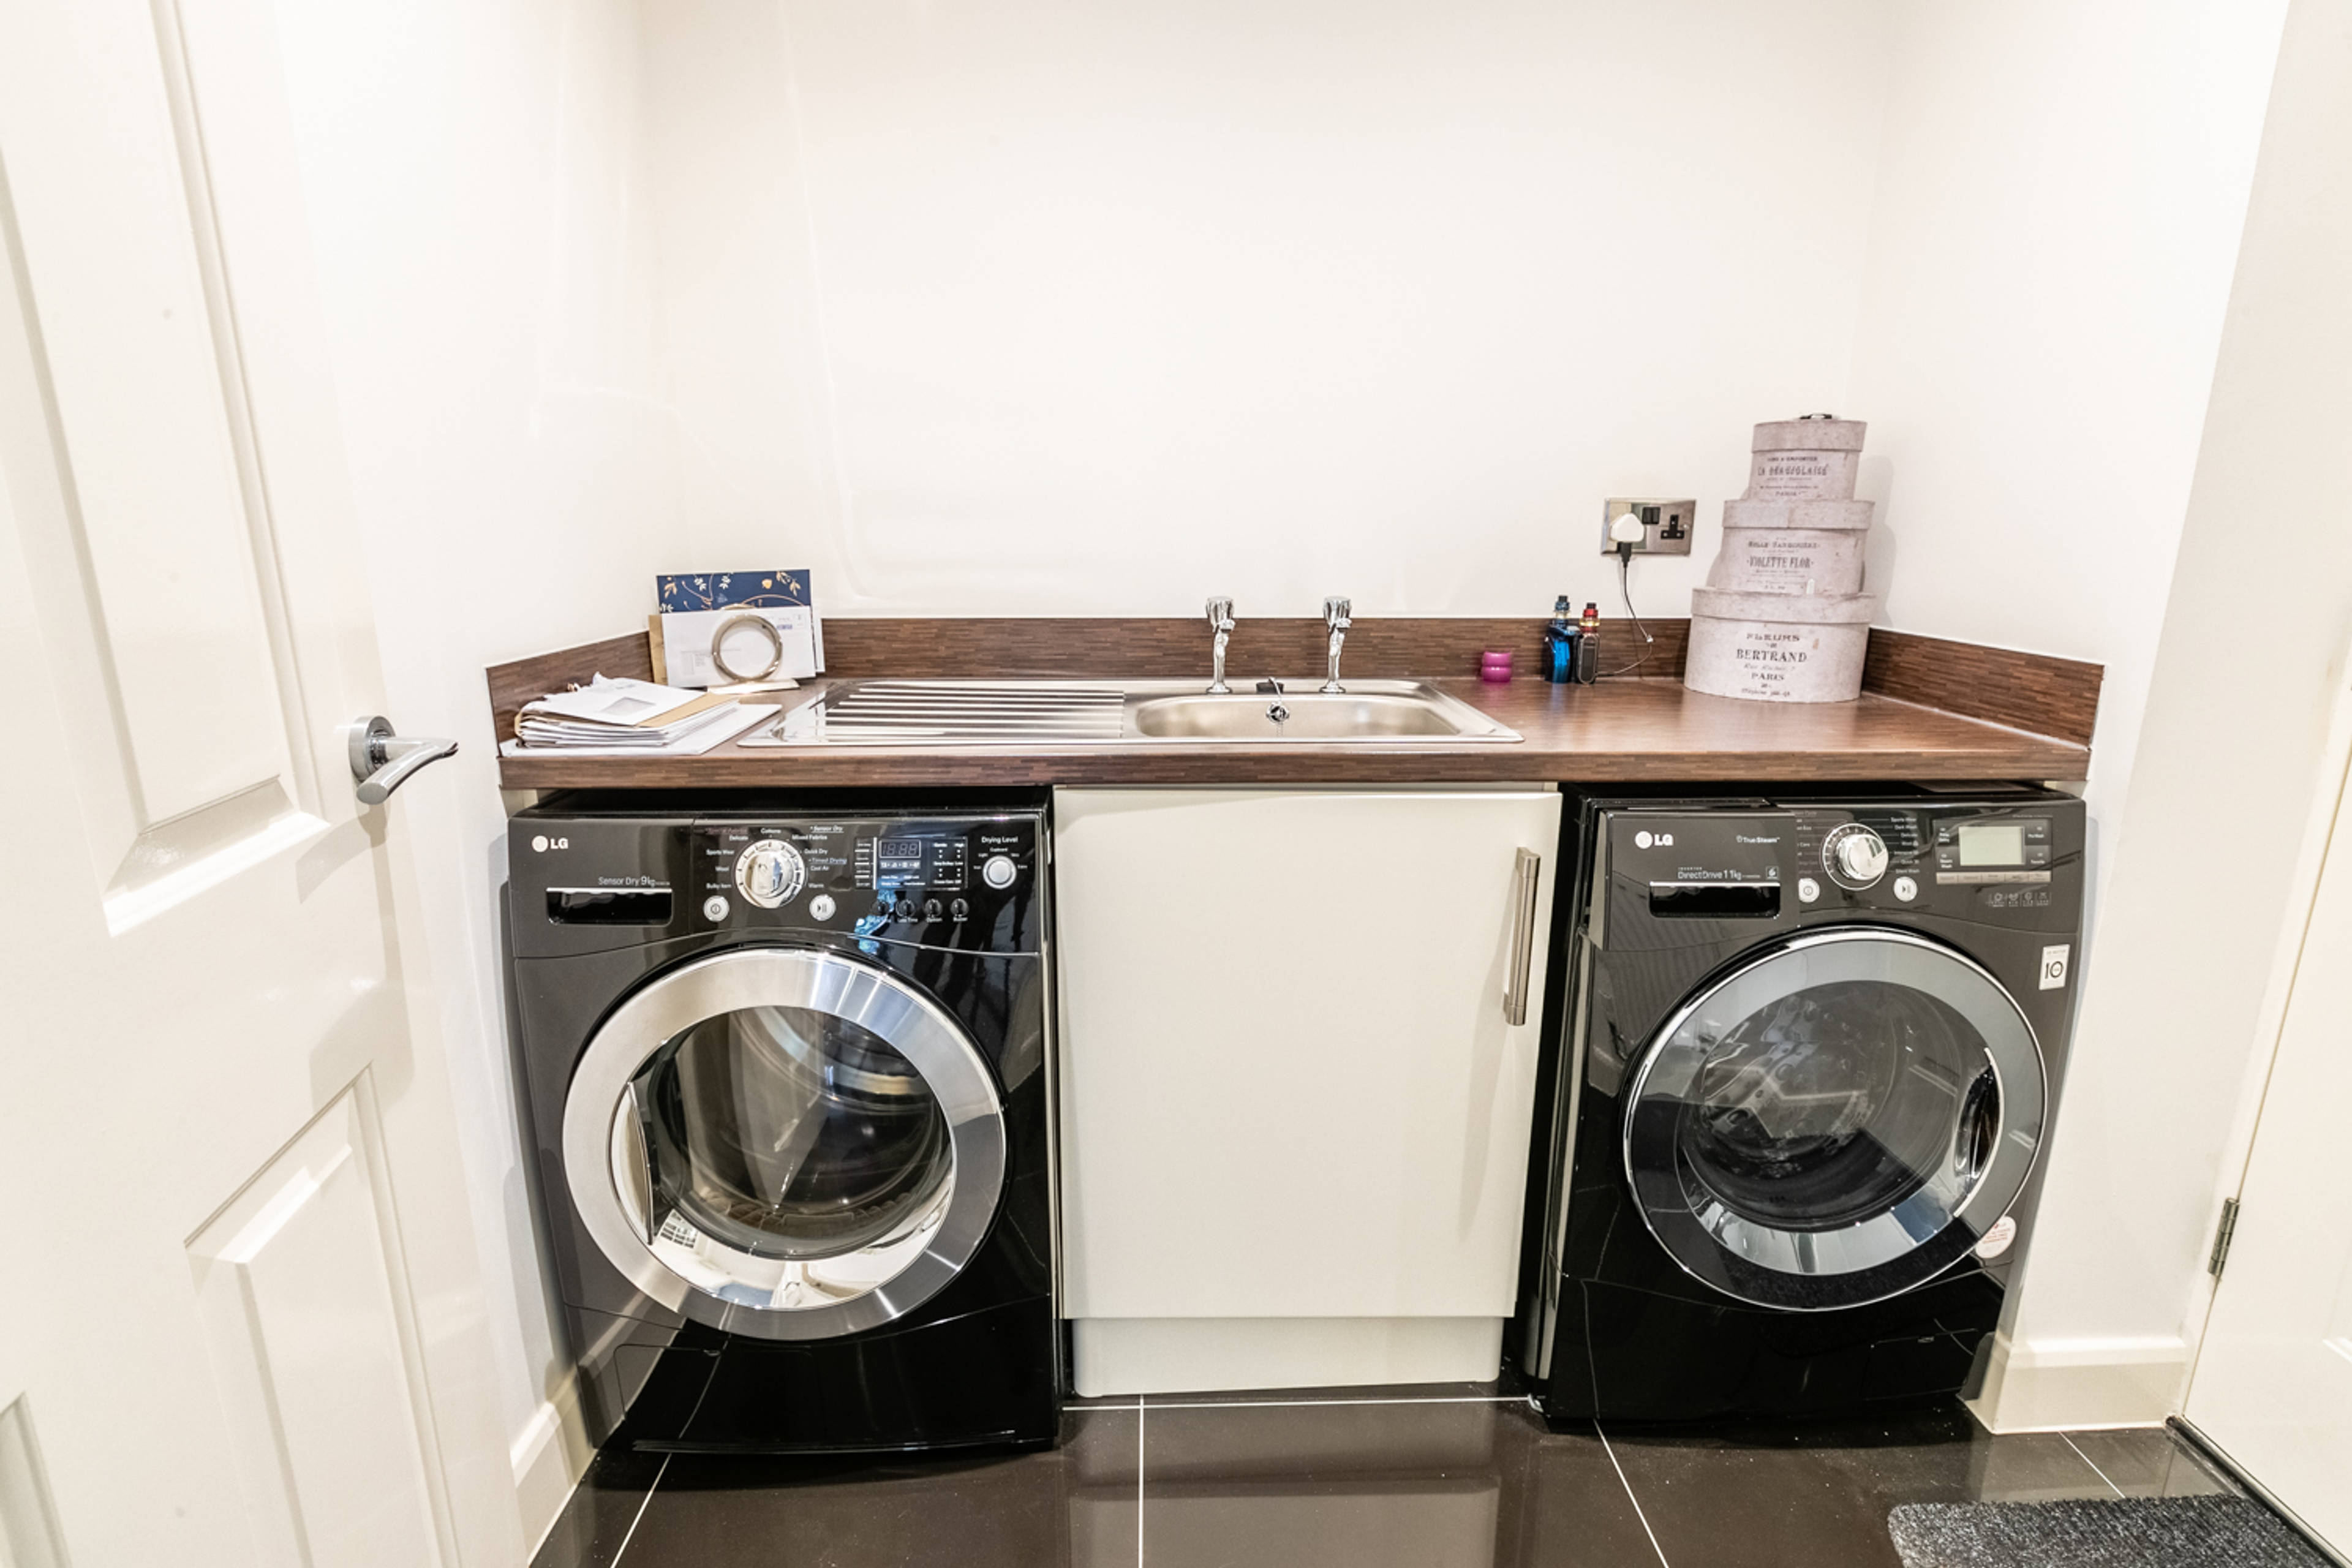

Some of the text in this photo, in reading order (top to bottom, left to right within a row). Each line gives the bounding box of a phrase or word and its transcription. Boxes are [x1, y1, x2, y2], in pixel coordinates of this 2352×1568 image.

[1736, 649, 1807, 662] BERTRAND
[1751, 672, 1785, 680] PARIS
[551, 838, 568, 849] LG
[1654, 834, 1673, 846] LG
[598, 876, 624, 886] Sensor
[625, 876, 639, 887] Dry
